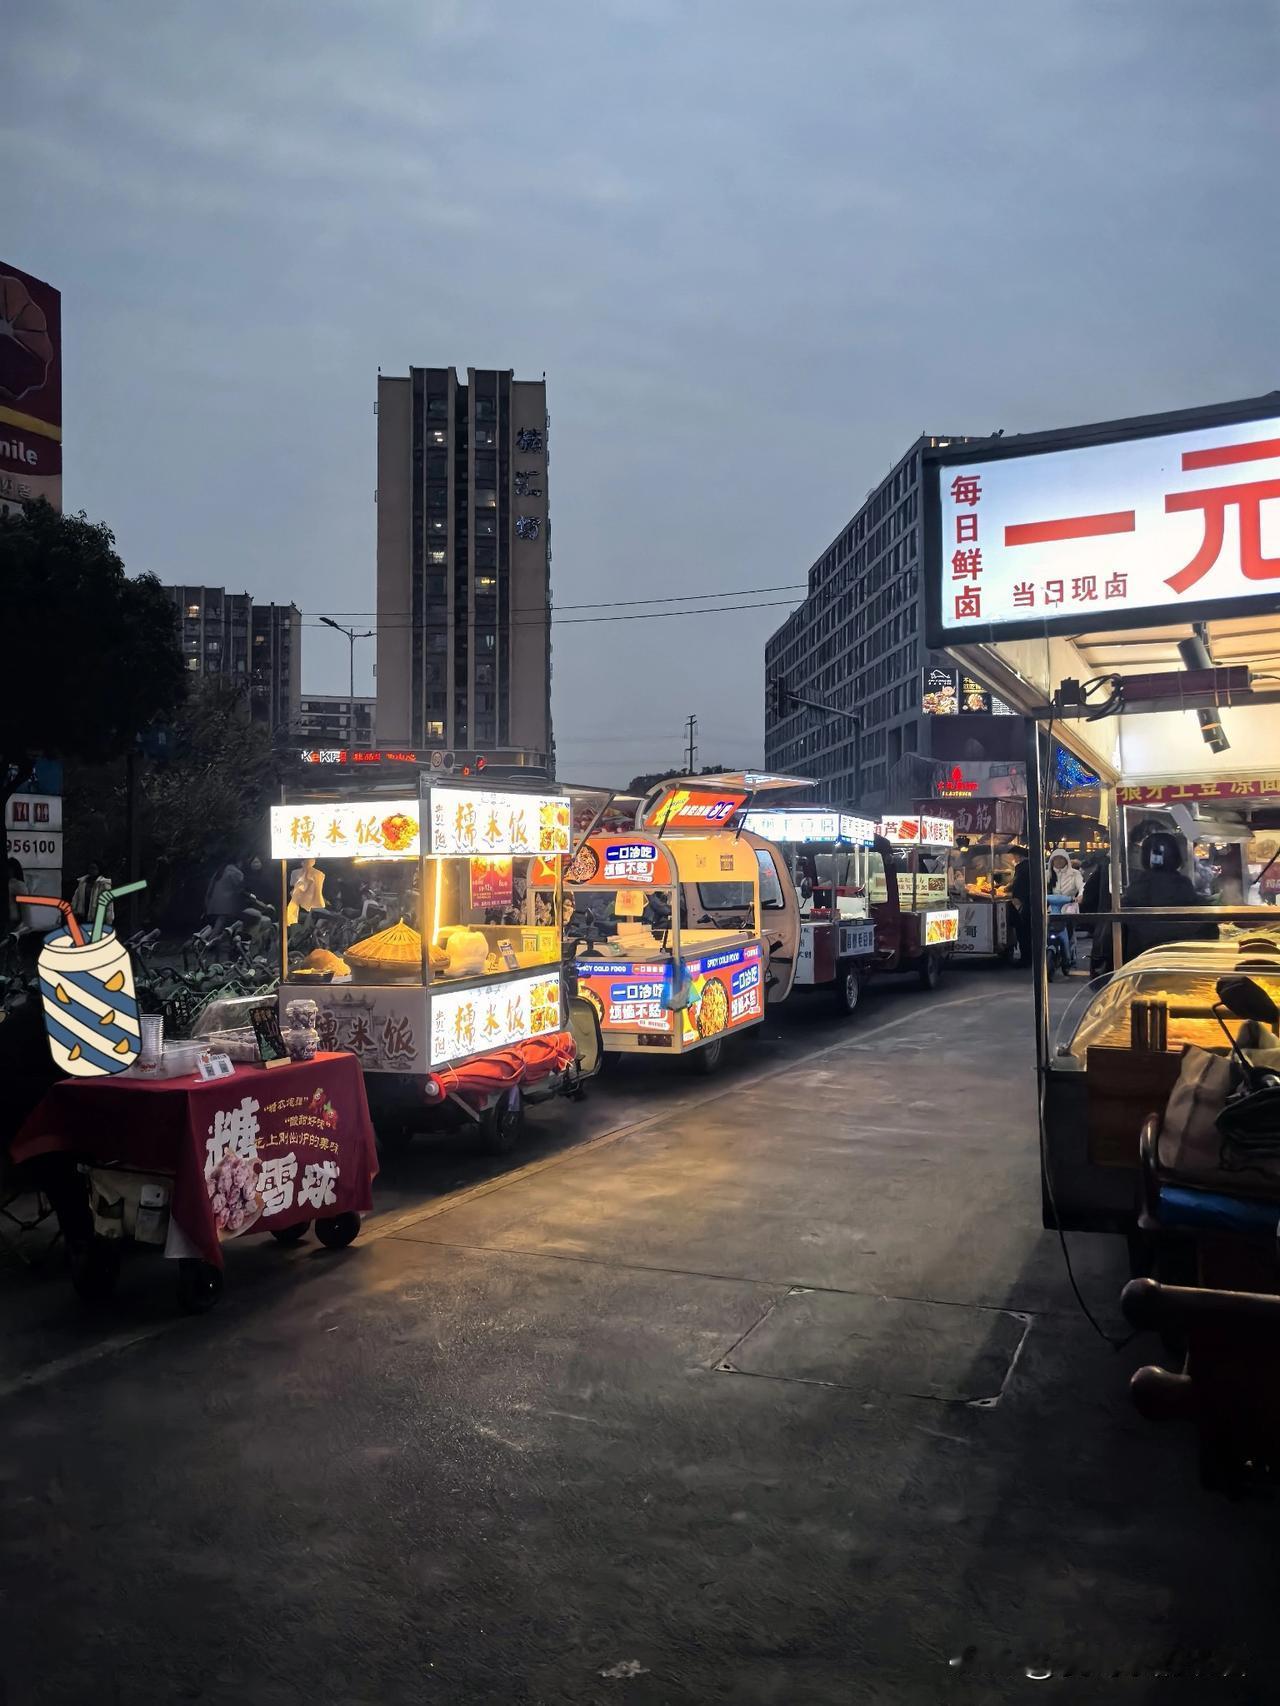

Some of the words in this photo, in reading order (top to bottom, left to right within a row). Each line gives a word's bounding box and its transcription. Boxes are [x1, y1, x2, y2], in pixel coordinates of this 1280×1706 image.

[951, 475, 983, 619] 每日鲜卤
[1013, 572, 1128, 608] 当日现卤
[290, 815, 382, 849] 糯米饭
[454, 802, 528, 847] 糯米饭
[607, 846, 652, 859] 一口冷吃
[613, 984, 664, 999] 一口冷吃
[454, 995, 525, 1046] 糯米饭
[256, 1152, 340, 1217] 雪球
